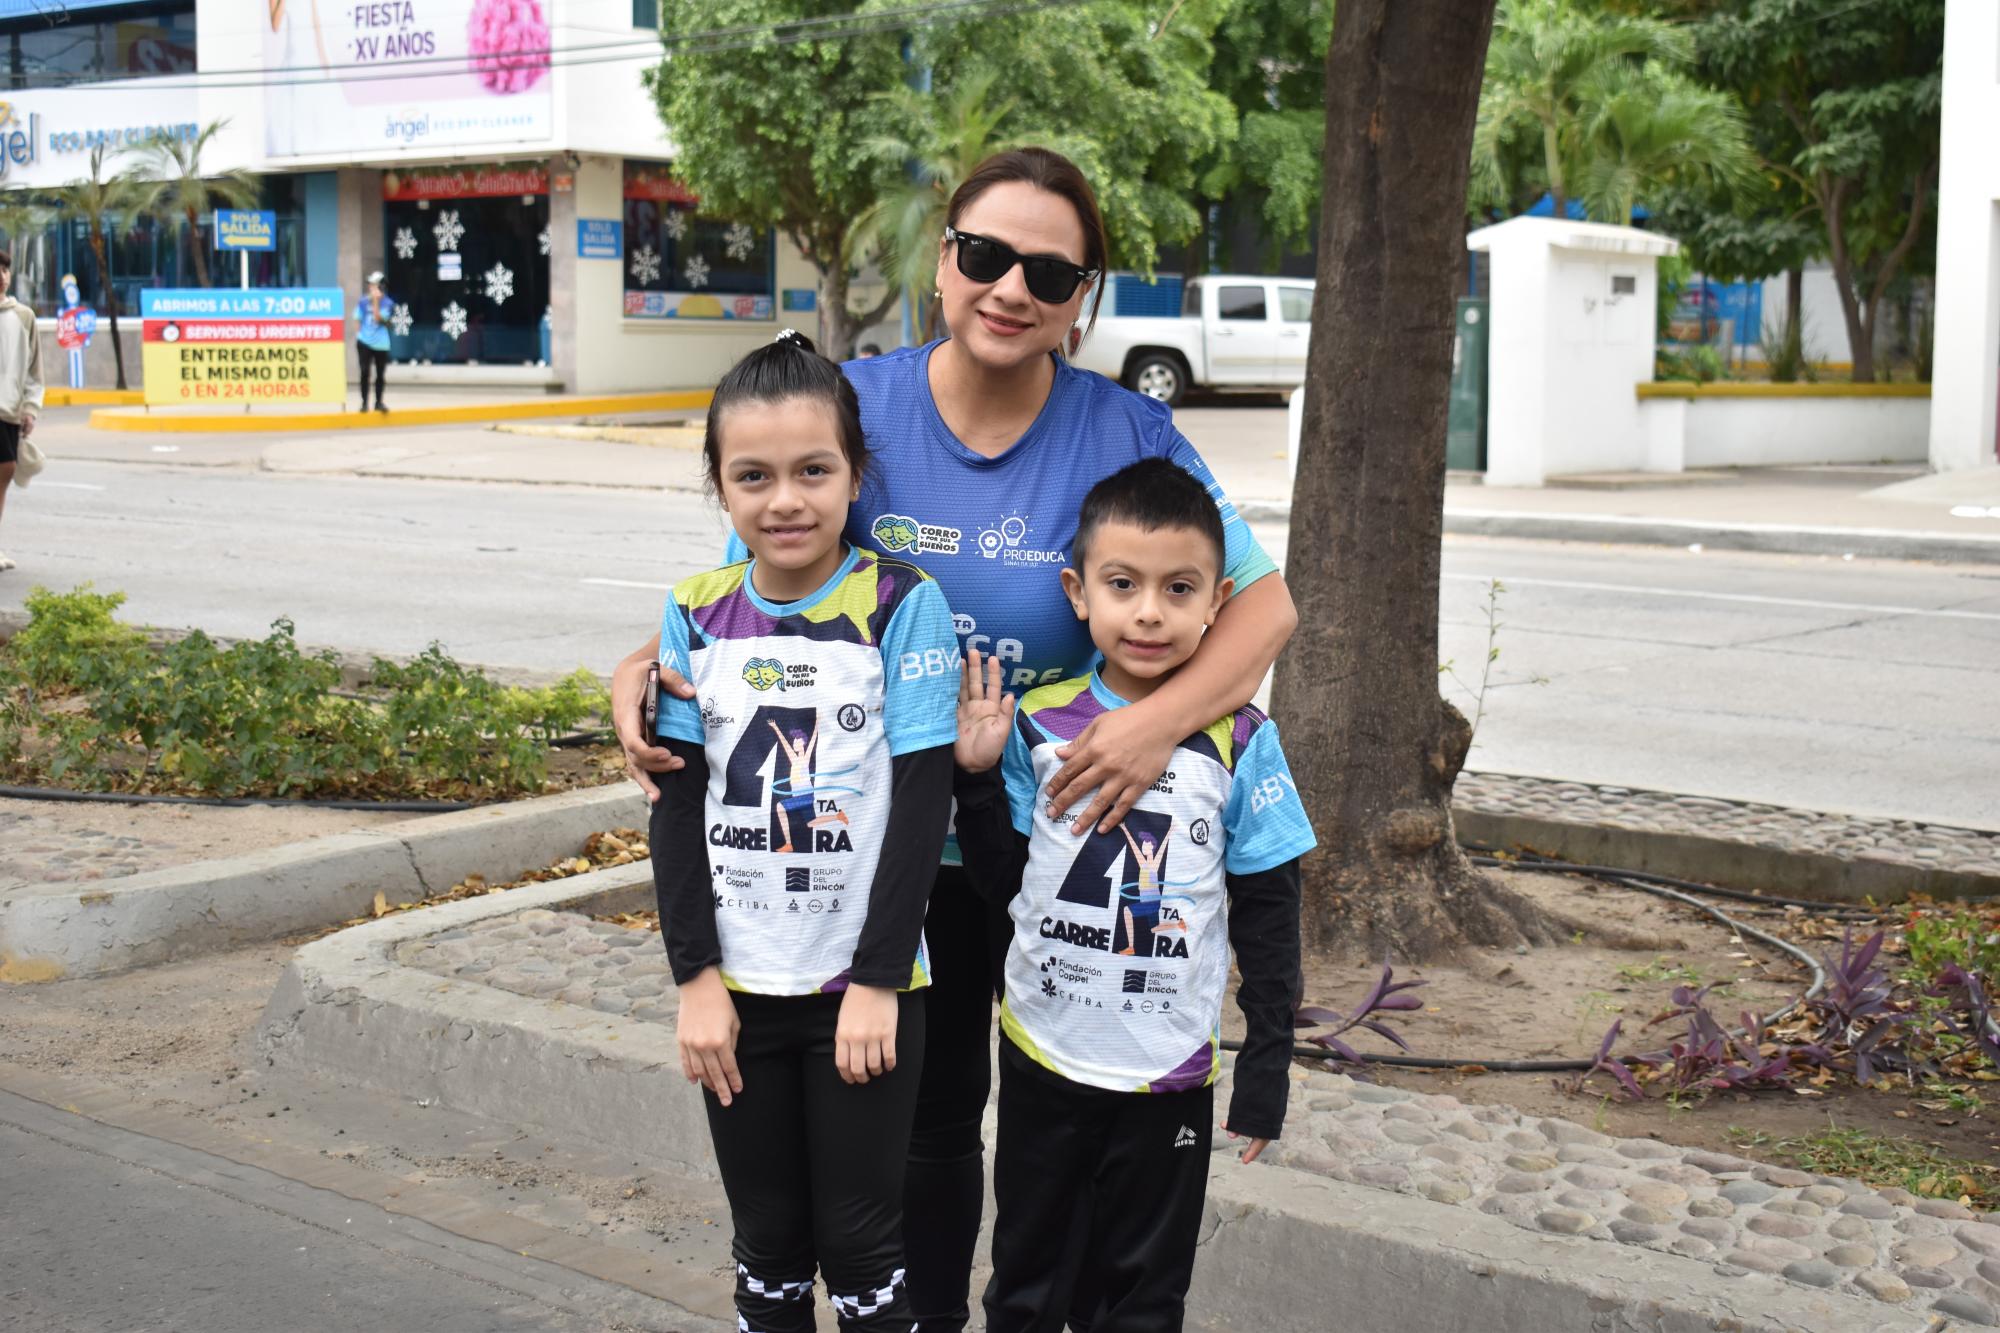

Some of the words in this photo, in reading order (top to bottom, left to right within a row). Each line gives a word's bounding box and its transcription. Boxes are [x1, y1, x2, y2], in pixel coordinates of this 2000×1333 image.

[355, 0, 415, 29] FIESTA
[355, 36, 379, 62] XV
[385, 26, 436, 57] AÑOS
[231, 213, 260, 223] SOLO
[221, 222, 271, 235] SALIDA
[588, 222, 612, 233] SOLO
[583, 233, 616, 245] SALIDA
[153, 299, 216, 313] ABRIMOS
[220, 299, 230, 313] A
[234, 299, 260, 313] LAS
[264, 297, 305, 314] 7:00
[308, 299, 331, 312] AM
[185, 325, 257, 340] SERVICIOS
[260, 324, 331, 339] URGENTES
[180, 348, 309, 363] ENTREGAMOS
[181, 366, 202, 380] EL
[208, 366, 272, 380] MISMO
[278, 362, 309, 380] DÍA
[196, 384, 218, 398] EN
[224, 384, 245, 398] 24
[250, 382, 310, 397] HORAS
[920, 527, 959, 539] CORRO
[919, 540, 957, 552] SUEÑOS
[1003, 549, 1066, 563] PROEDUCA
[726, 866, 764, 879] Fundación
[813, 868, 842, 876] GRUPO
[726, 877, 752, 889] Coppel
[813, 883, 845, 892] RINCÓN
[1058, 959, 1102, 977] Fundación
[1058, 969, 1089, 985] Coppel
[1149, 971, 1177, 980] GRUPO
[1147, 986, 1178, 995] RINCÓN
[1059, 990, 1103, 1009] CEIBA
